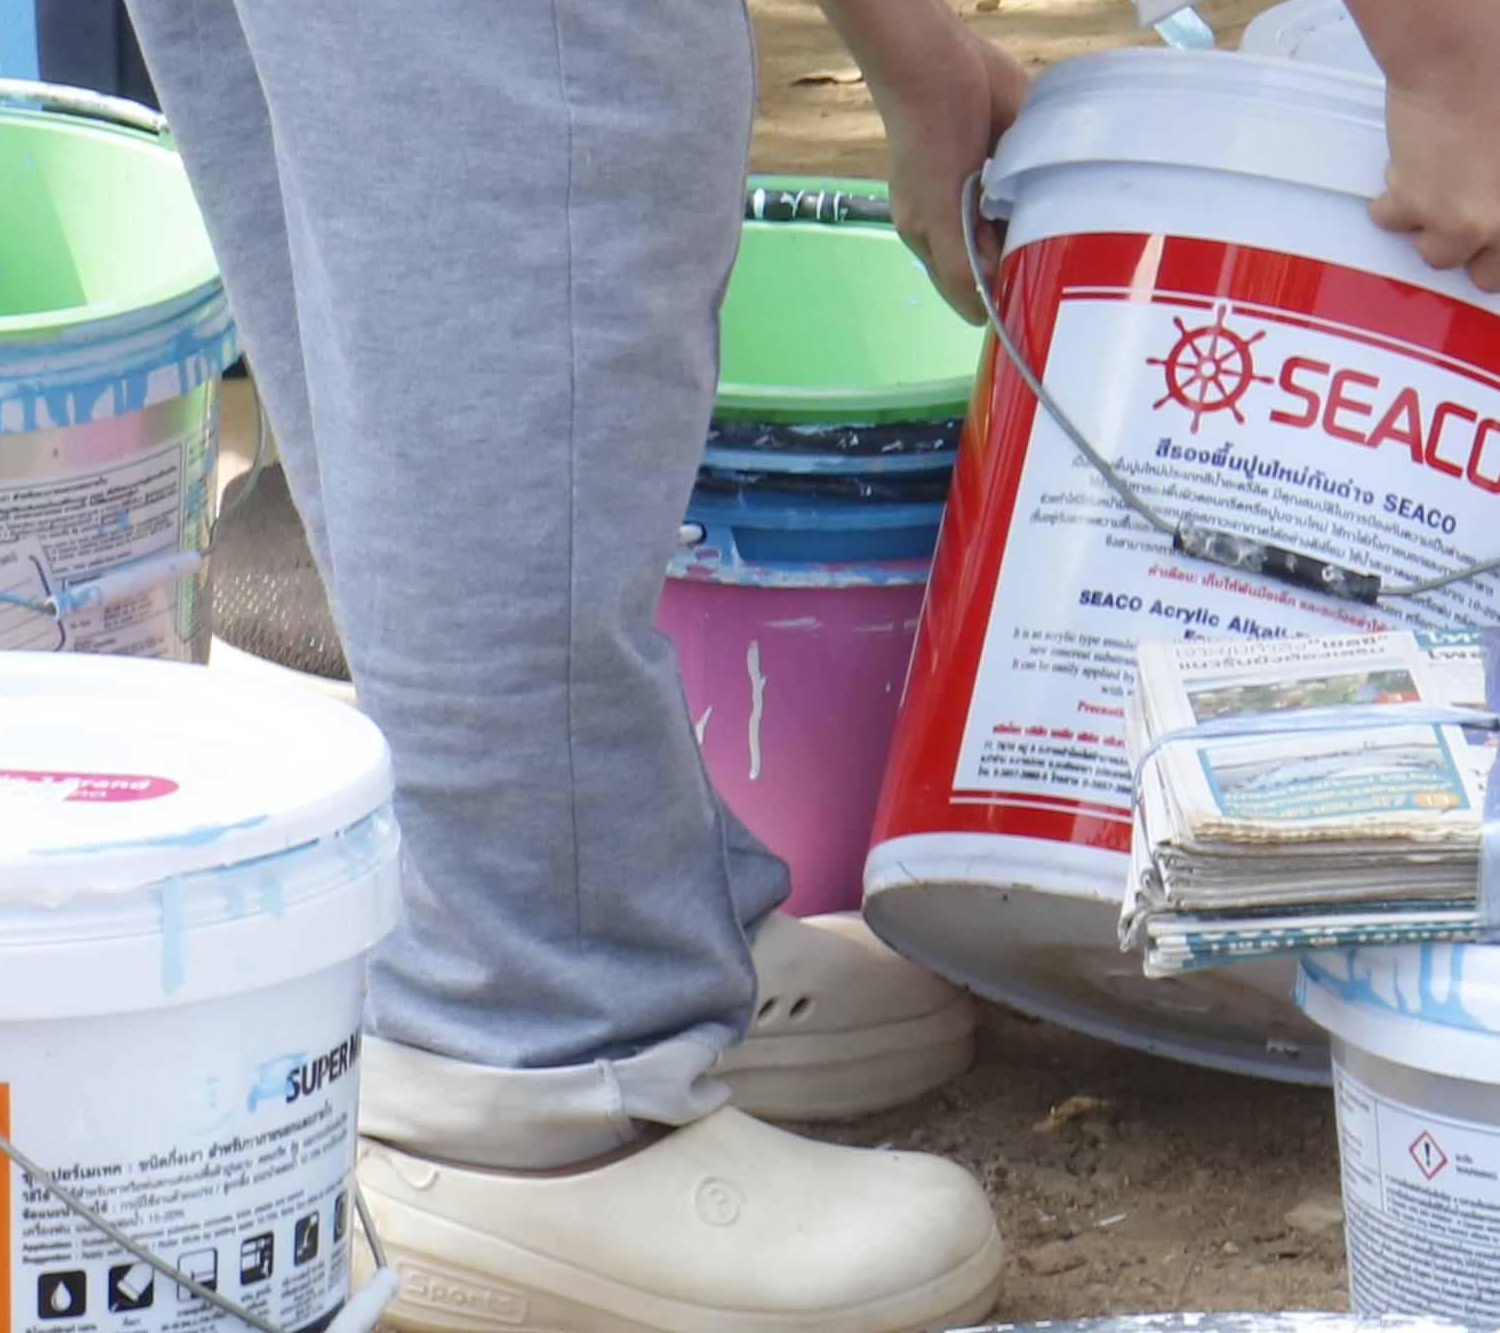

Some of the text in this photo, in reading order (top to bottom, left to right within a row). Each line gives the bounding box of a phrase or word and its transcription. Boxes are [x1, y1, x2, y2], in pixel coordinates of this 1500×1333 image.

[1383, 494, 1457, 535] SEACO
[1079, 589, 1143, 613] SEACO
[1150, 600, 1220, 628] Acrylic
[285, 1038, 349, 1104] SUPER
